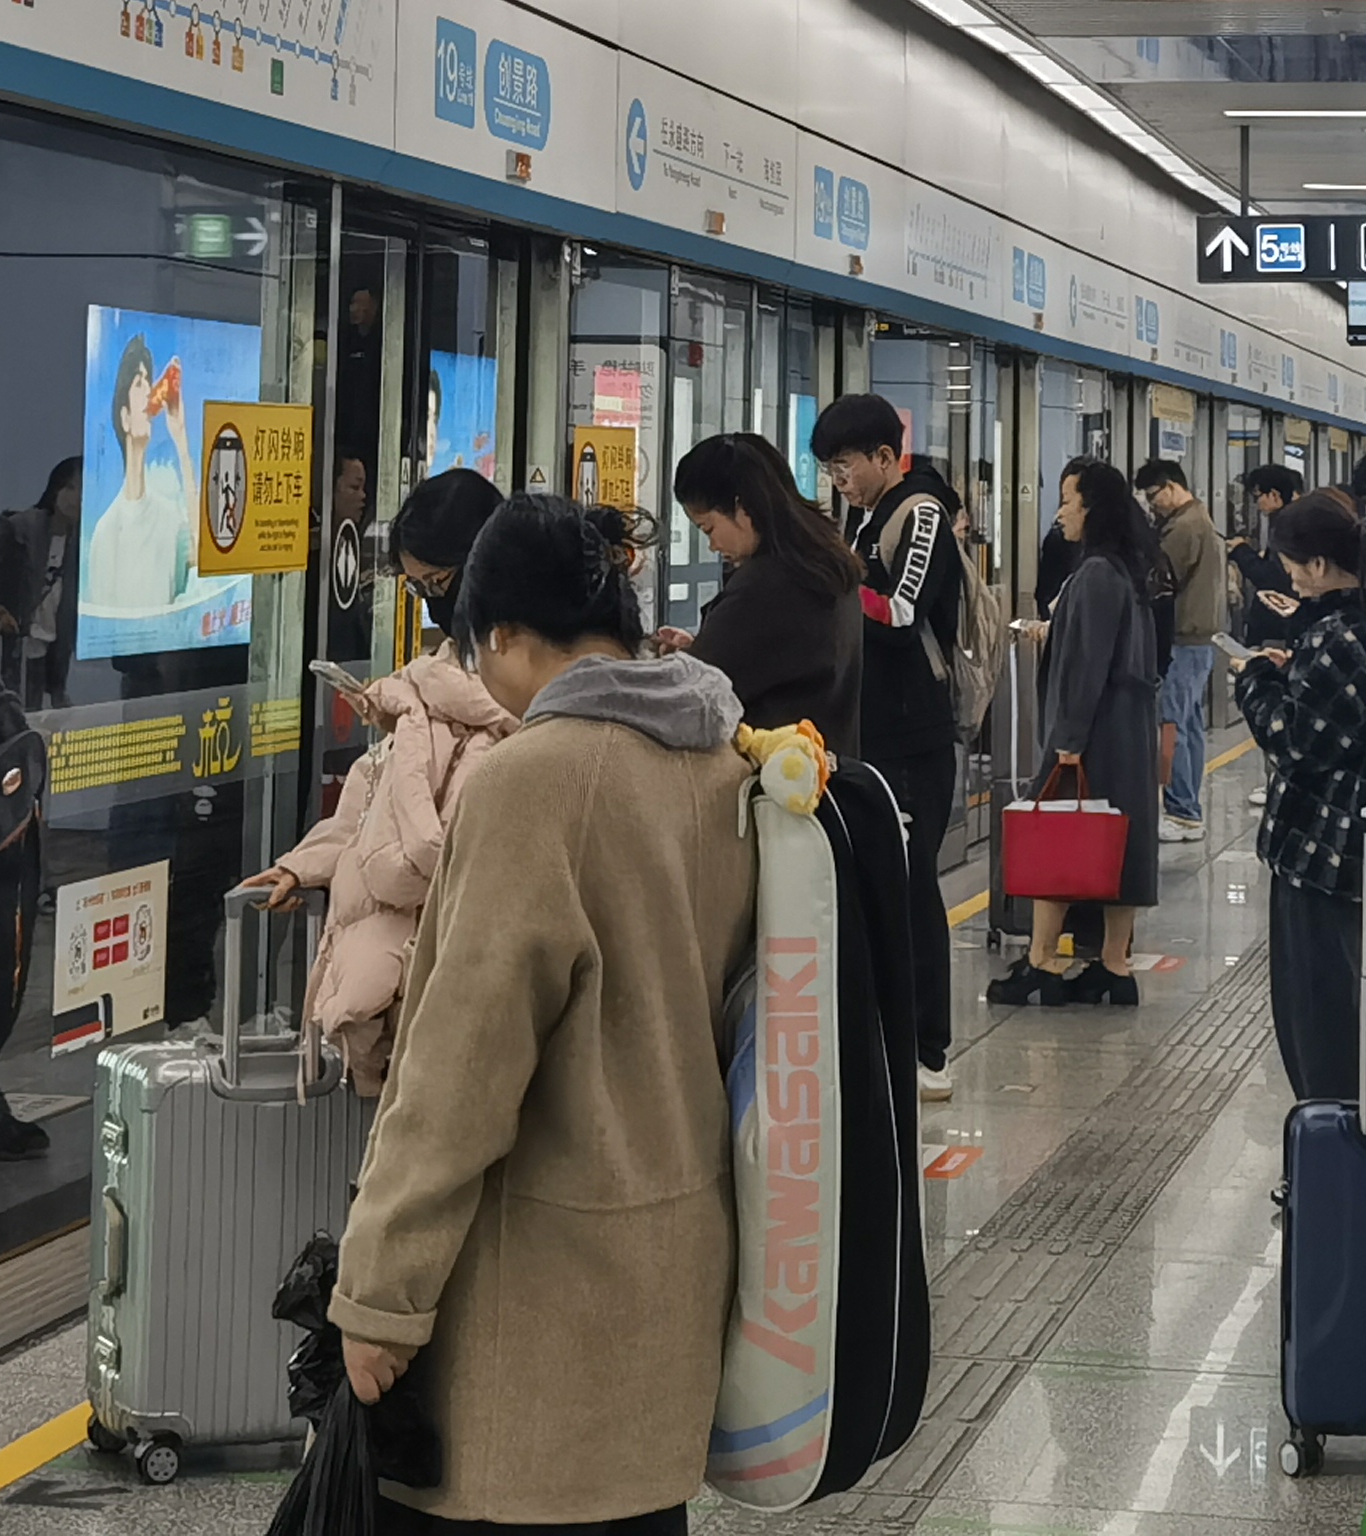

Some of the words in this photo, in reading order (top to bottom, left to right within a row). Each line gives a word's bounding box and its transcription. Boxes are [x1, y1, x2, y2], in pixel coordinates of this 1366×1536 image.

[498, 52, 539, 107] 创景路
[252, 425, 305, 463] 灯闪铃响
[252, 469, 304, 506] 请勿上下车
